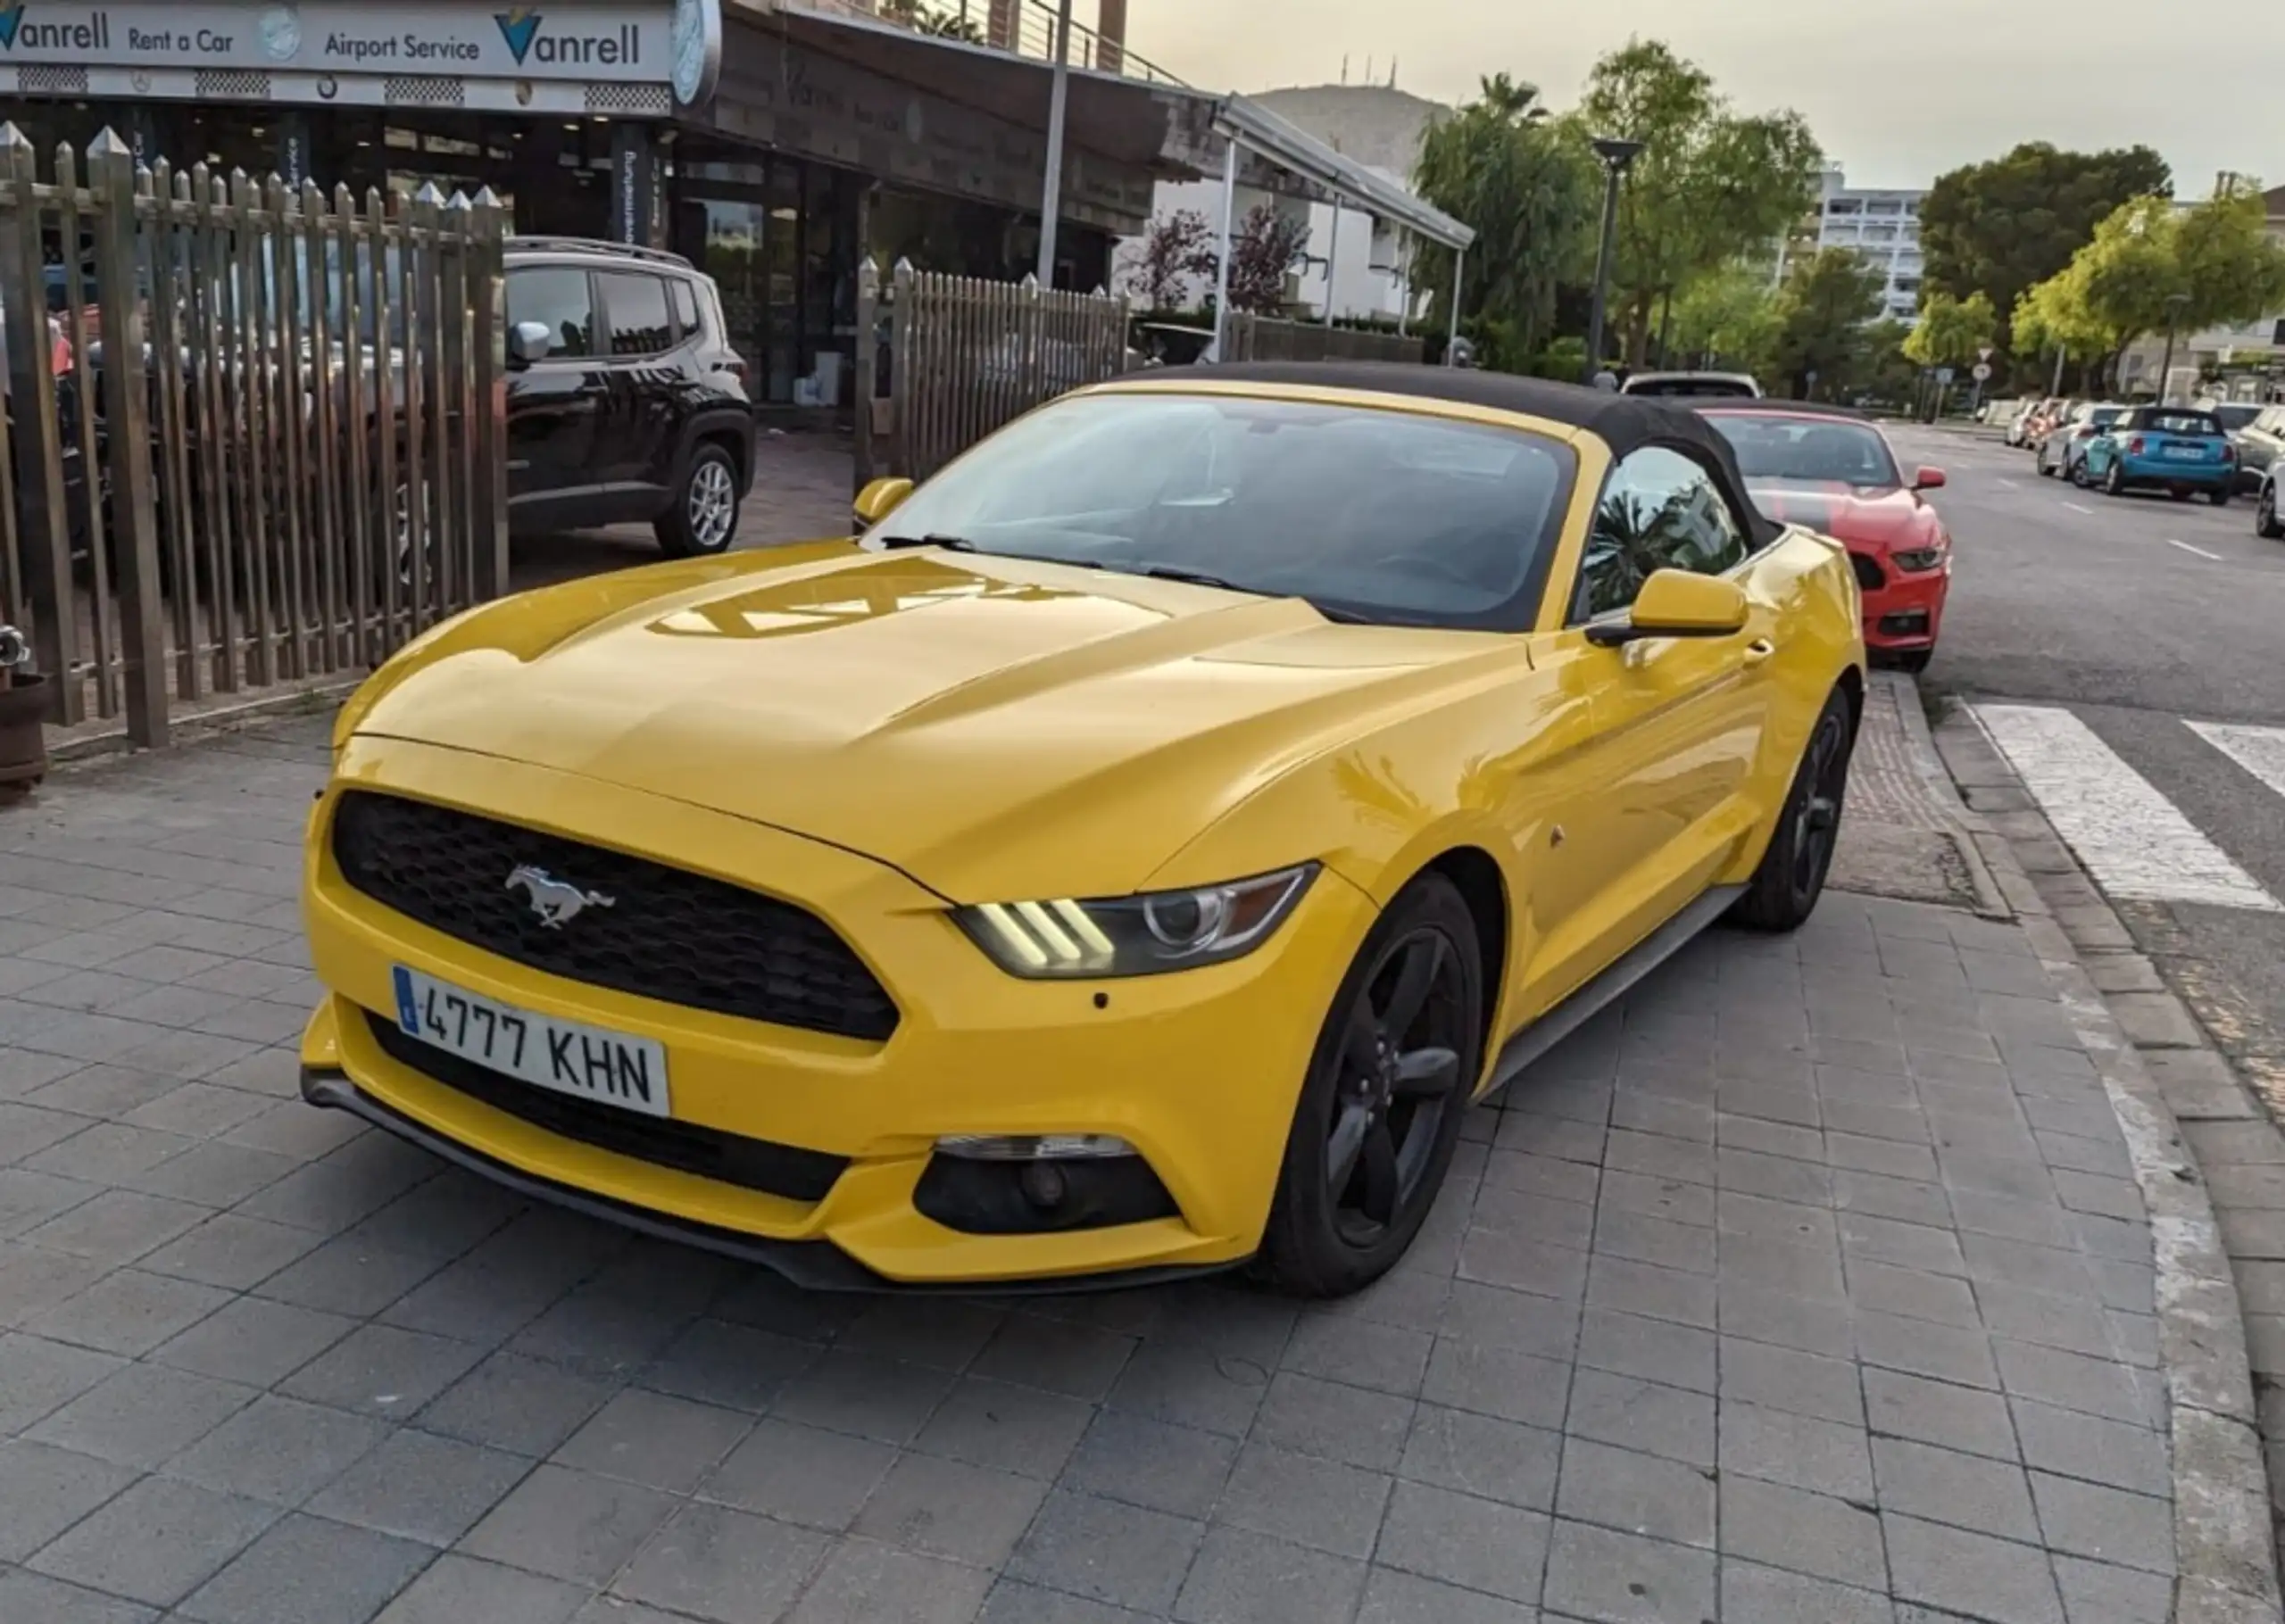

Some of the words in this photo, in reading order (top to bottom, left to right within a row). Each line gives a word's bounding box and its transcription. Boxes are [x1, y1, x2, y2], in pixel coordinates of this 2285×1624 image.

[129, 28, 170, 51] Rent
[178, 34, 190, 51] a
[196, 29, 234, 52] Car
[325, 33, 397, 61] Airport
[403, 34, 479, 60] Service
[494, 13, 640, 66] Vanrell
[426, 988, 527, 1068] 4777
[547, 1027, 651, 1103] KHN
